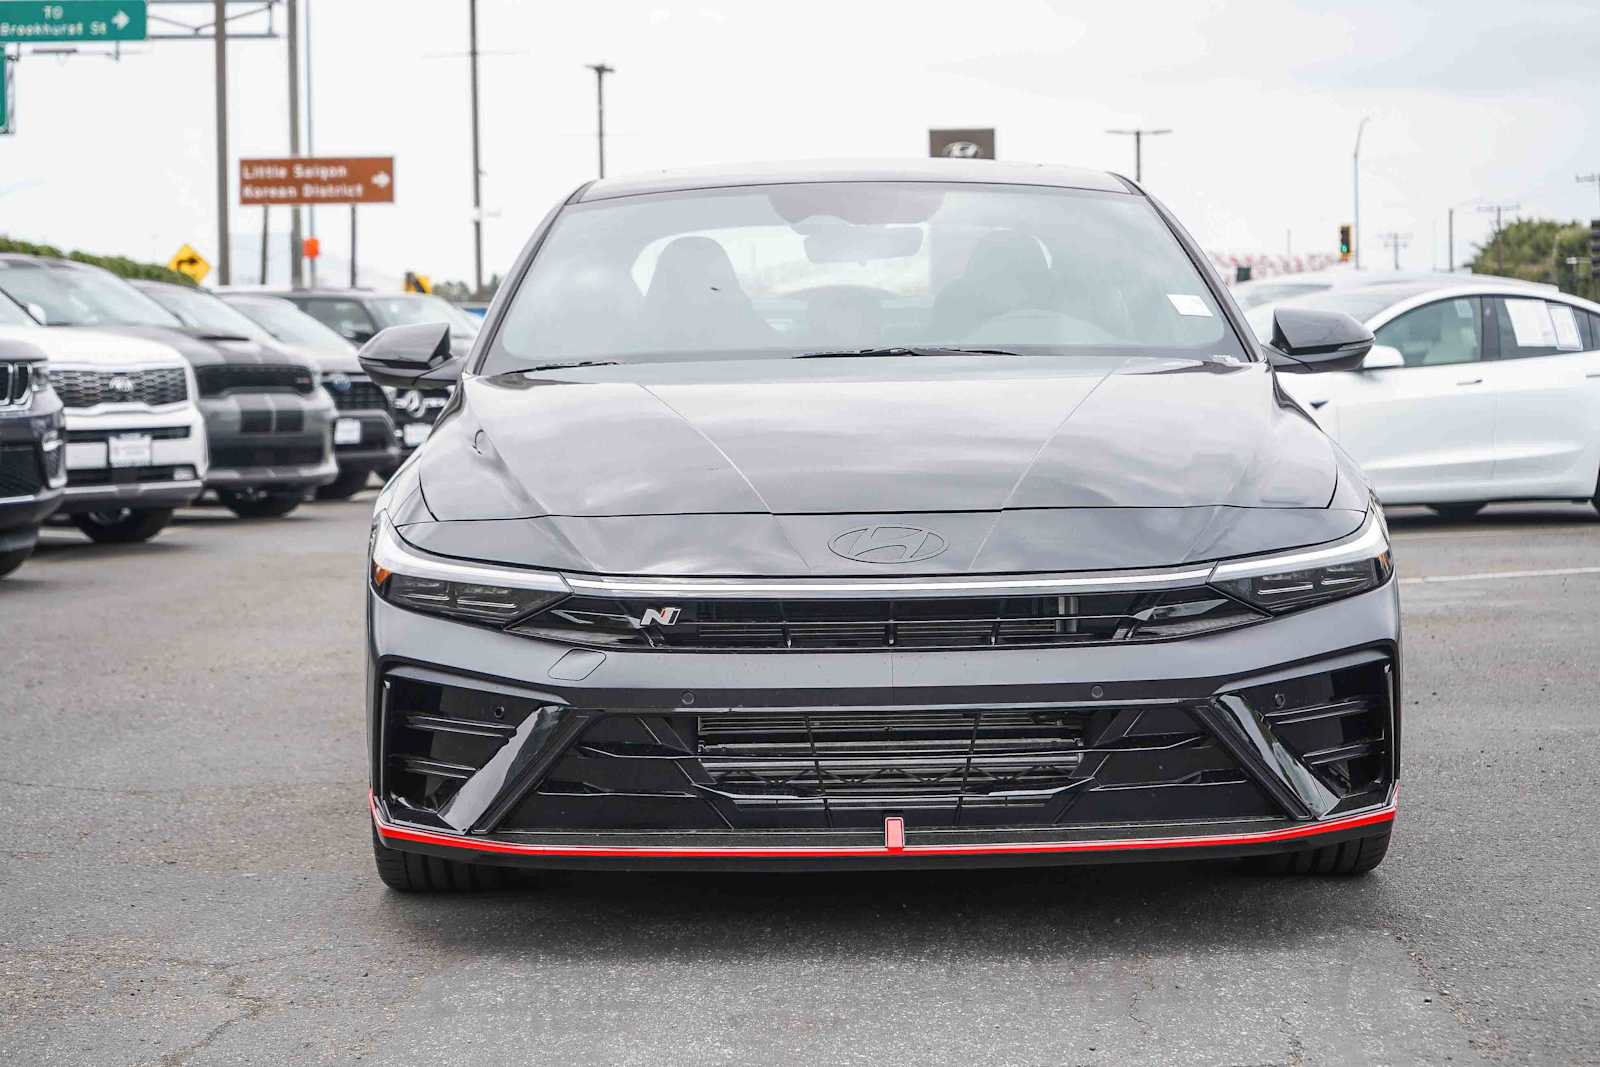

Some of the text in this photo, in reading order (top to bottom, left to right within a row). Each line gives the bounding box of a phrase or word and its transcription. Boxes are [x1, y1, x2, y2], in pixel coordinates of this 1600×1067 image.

[0, 21, 107, 36] Brookhurst St
[242, 164, 347, 181] Little Saigon
[242, 183, 363, 198] Korean District
[641, 607, 681, 626] N
